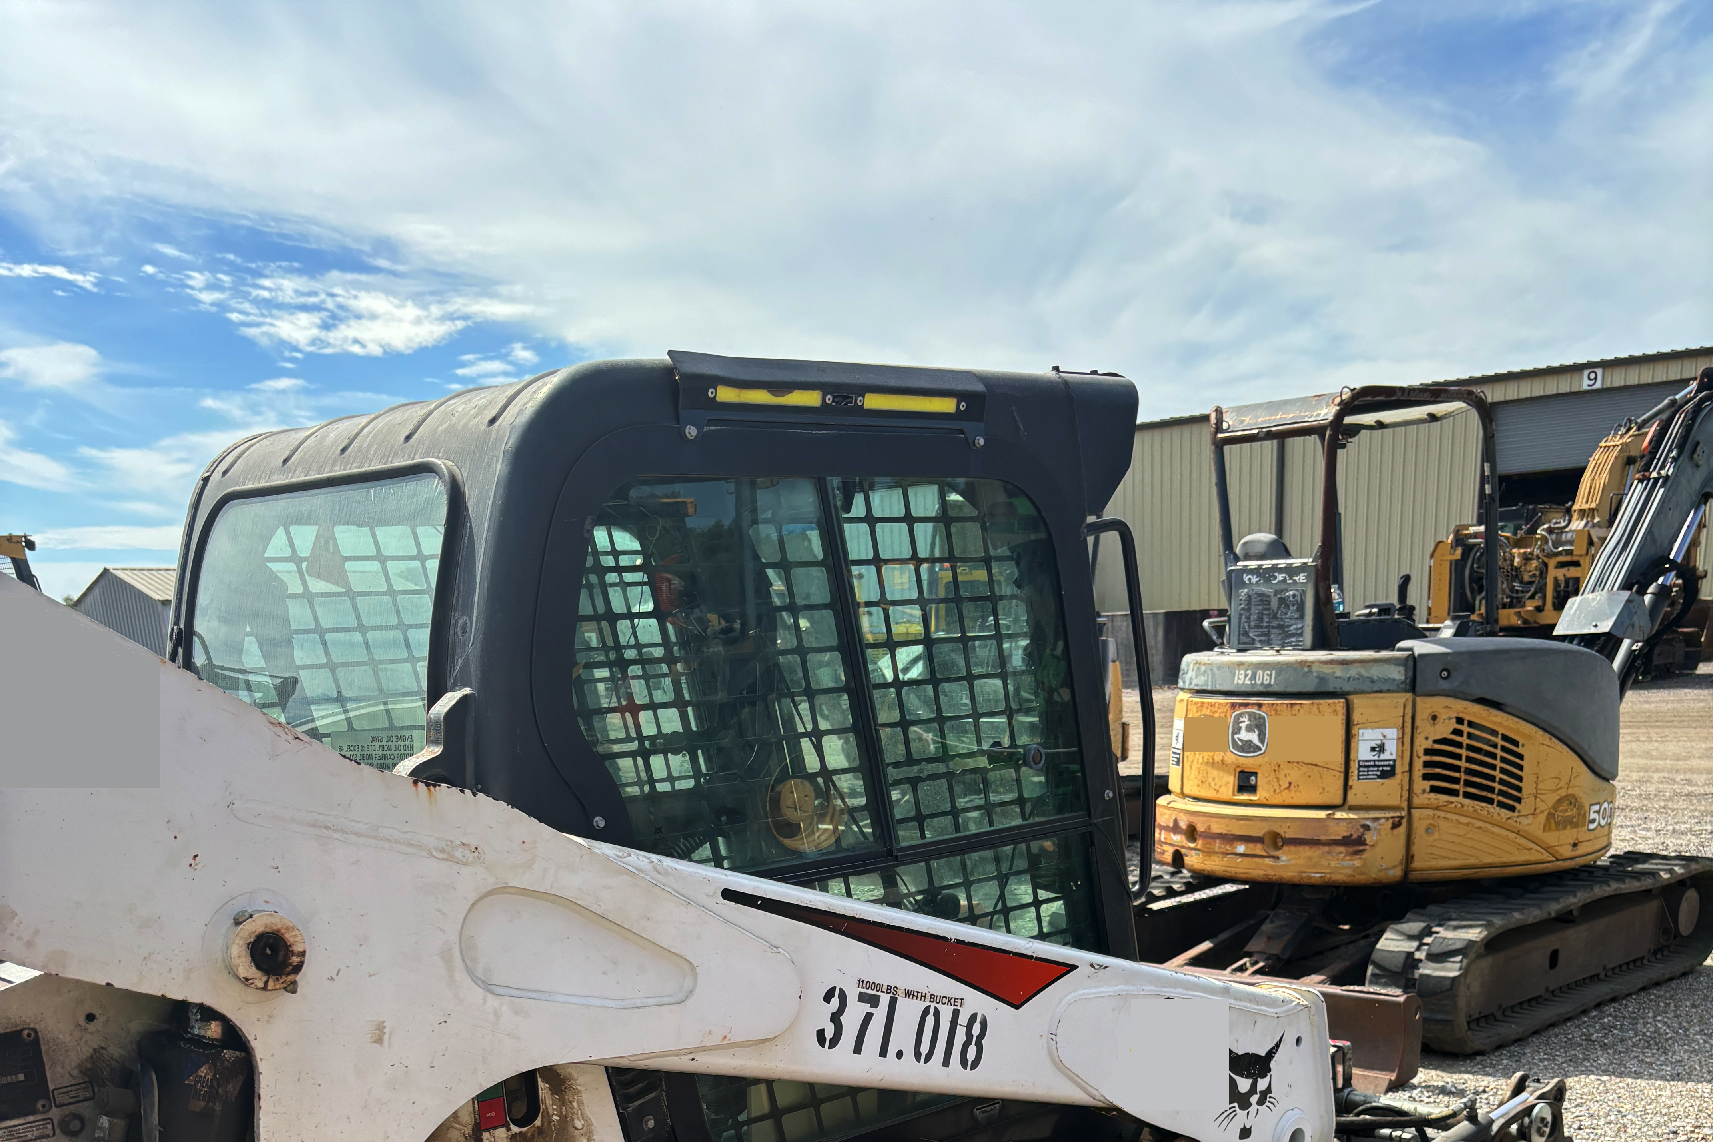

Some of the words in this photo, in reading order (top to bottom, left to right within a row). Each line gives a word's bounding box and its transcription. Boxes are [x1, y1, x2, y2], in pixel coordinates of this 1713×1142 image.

[1587, 370, 1598, 387] 9
[1233, 669, 1276, 685] 192.061
[903, 987, 927, 1002] WITH
[929, 993, 965, 1008] BUCKET
[815, 985, 988, 1071] 371.018
